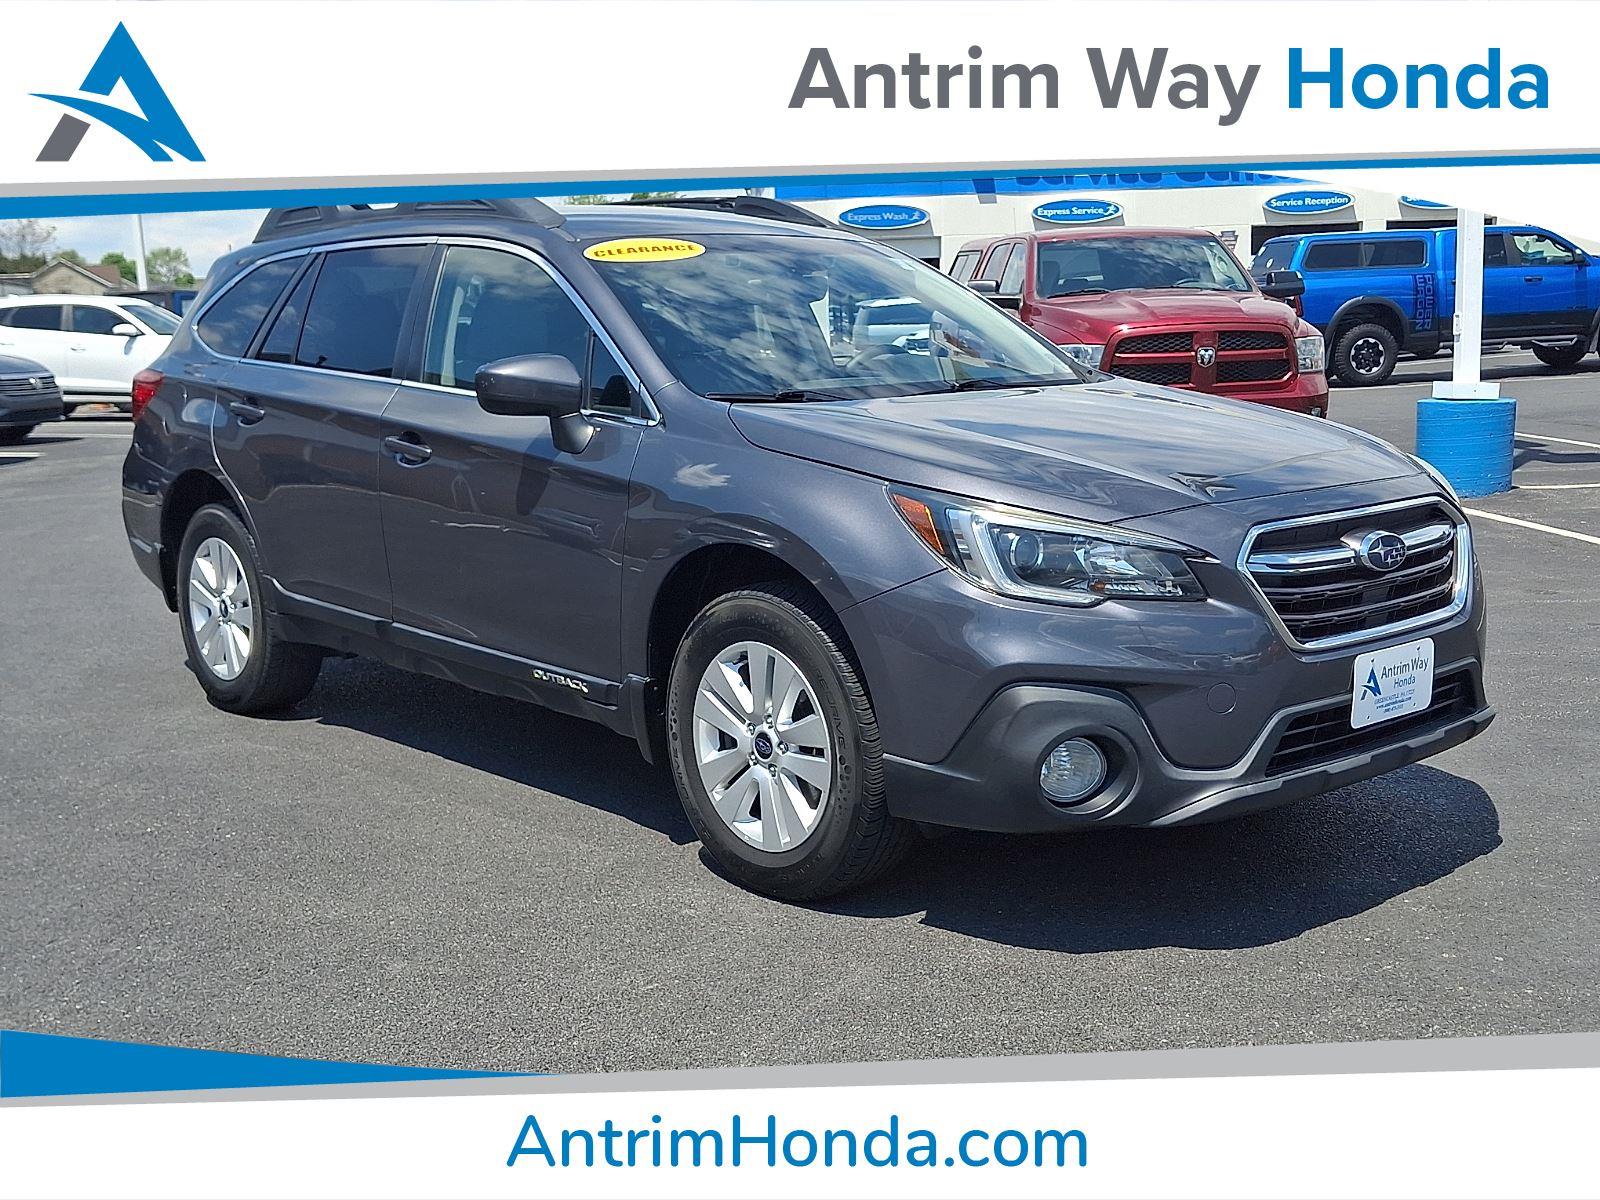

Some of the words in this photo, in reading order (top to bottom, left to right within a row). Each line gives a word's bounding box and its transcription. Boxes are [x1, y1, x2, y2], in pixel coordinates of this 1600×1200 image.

[1270, 198, 1304, 208] Service
[1304, 196, 1349, 207] Reception
[847, 212, 881, 223] Express
[882, 211, 909, 221] Wash
[1037, 207, 1071, 217] Express
[1071, 205, 1105, 216] Service
[593, 244, 697, 258] CLEARANCE
[1415, 274, 1425, 330] WAGON
[1424, 274, 1434, 330] POWER
[1380, 661, 1410, 680] Antrim
[1411, 656, 1429, 672] Way
[532, 668, 589, 693] OUTBACK
[1393, 673, 1416, 689] Honda
